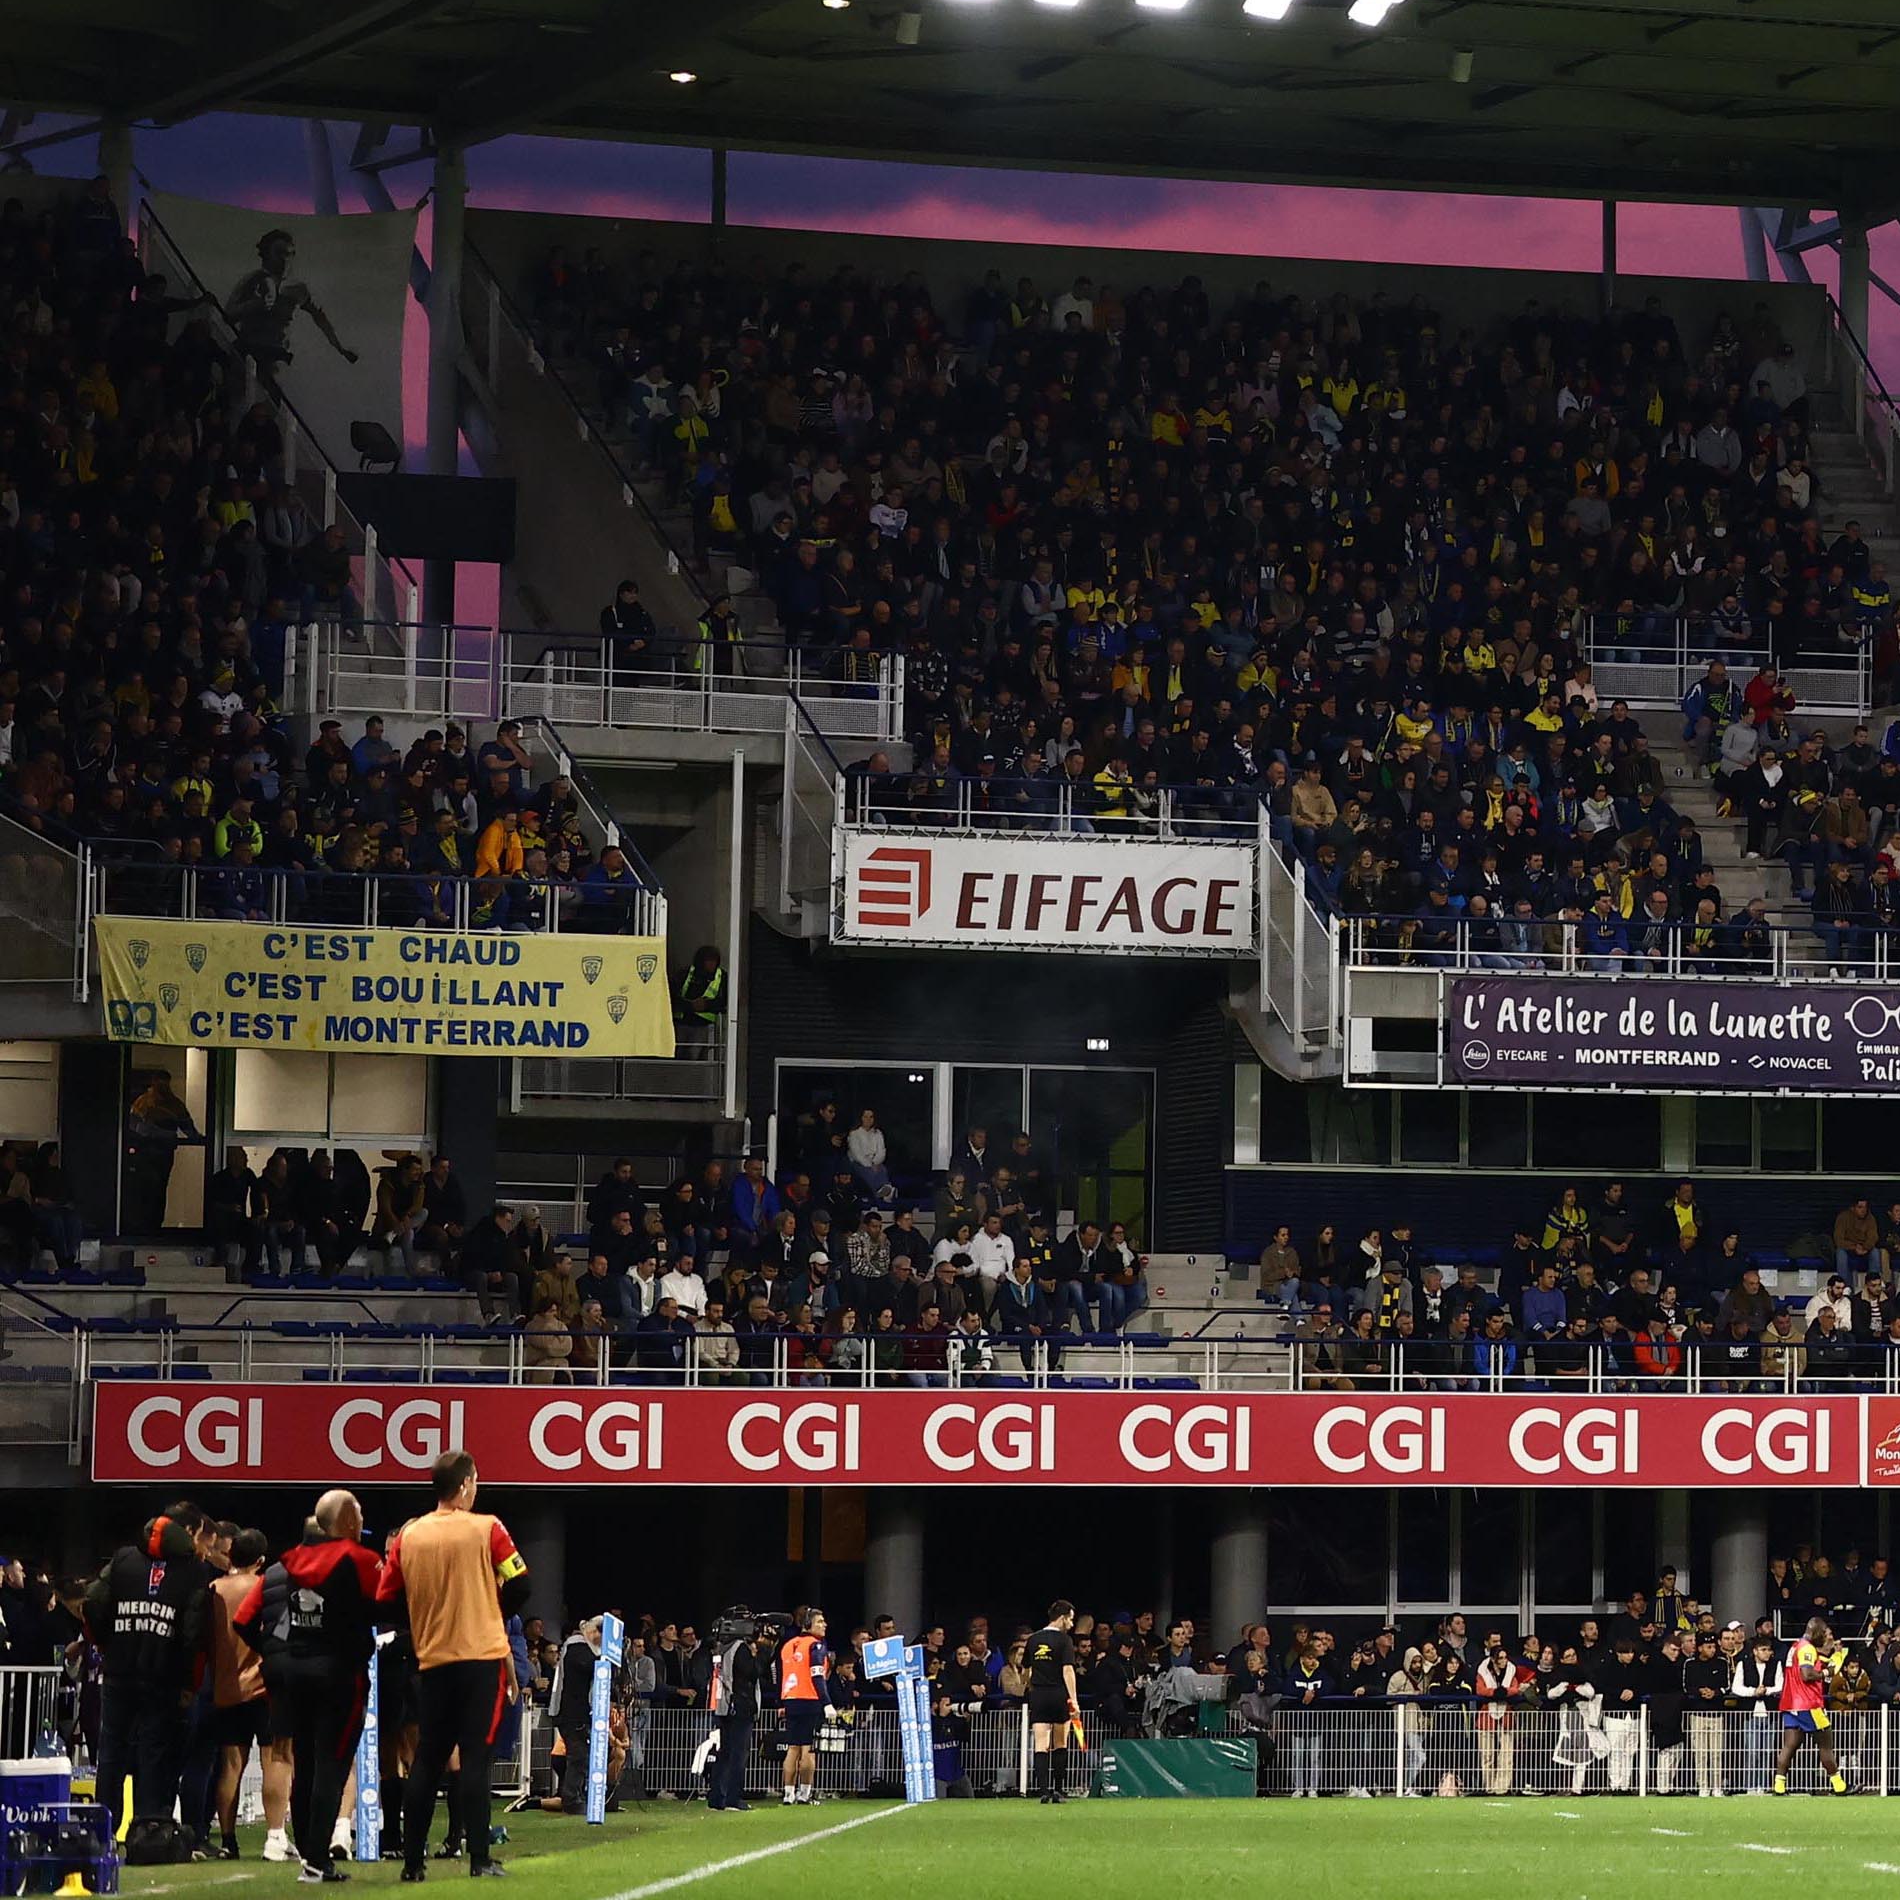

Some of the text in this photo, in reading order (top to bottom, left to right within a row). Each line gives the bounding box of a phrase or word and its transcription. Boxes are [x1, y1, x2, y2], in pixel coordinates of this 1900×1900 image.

[956, 872, 1240, 936] EIFFAGE
[263, 932, 521, 967] C'EST CHAUD
[224, 971, 327, 1002] C'EST
[191, 1011, 590, 1049] C'EST MONTFERRAND
[1618, 997, 1656, 1038] de
[1668, 1000, 1699, 1037] la
[1709, 1001, 1833, 1043] Lunette
[1496, 1048, 1549, 1063] EYECARE
[1574, 1048, 1721, 1068] MONTFERRAND
[1769, 1056, 1832, 1071] NOVACEL
[128, 1397, 1829, 1474] CGI CGI CGI CGI CGI CGI CGI CGI CGI
[114, 1618, 134, 1634] DE
